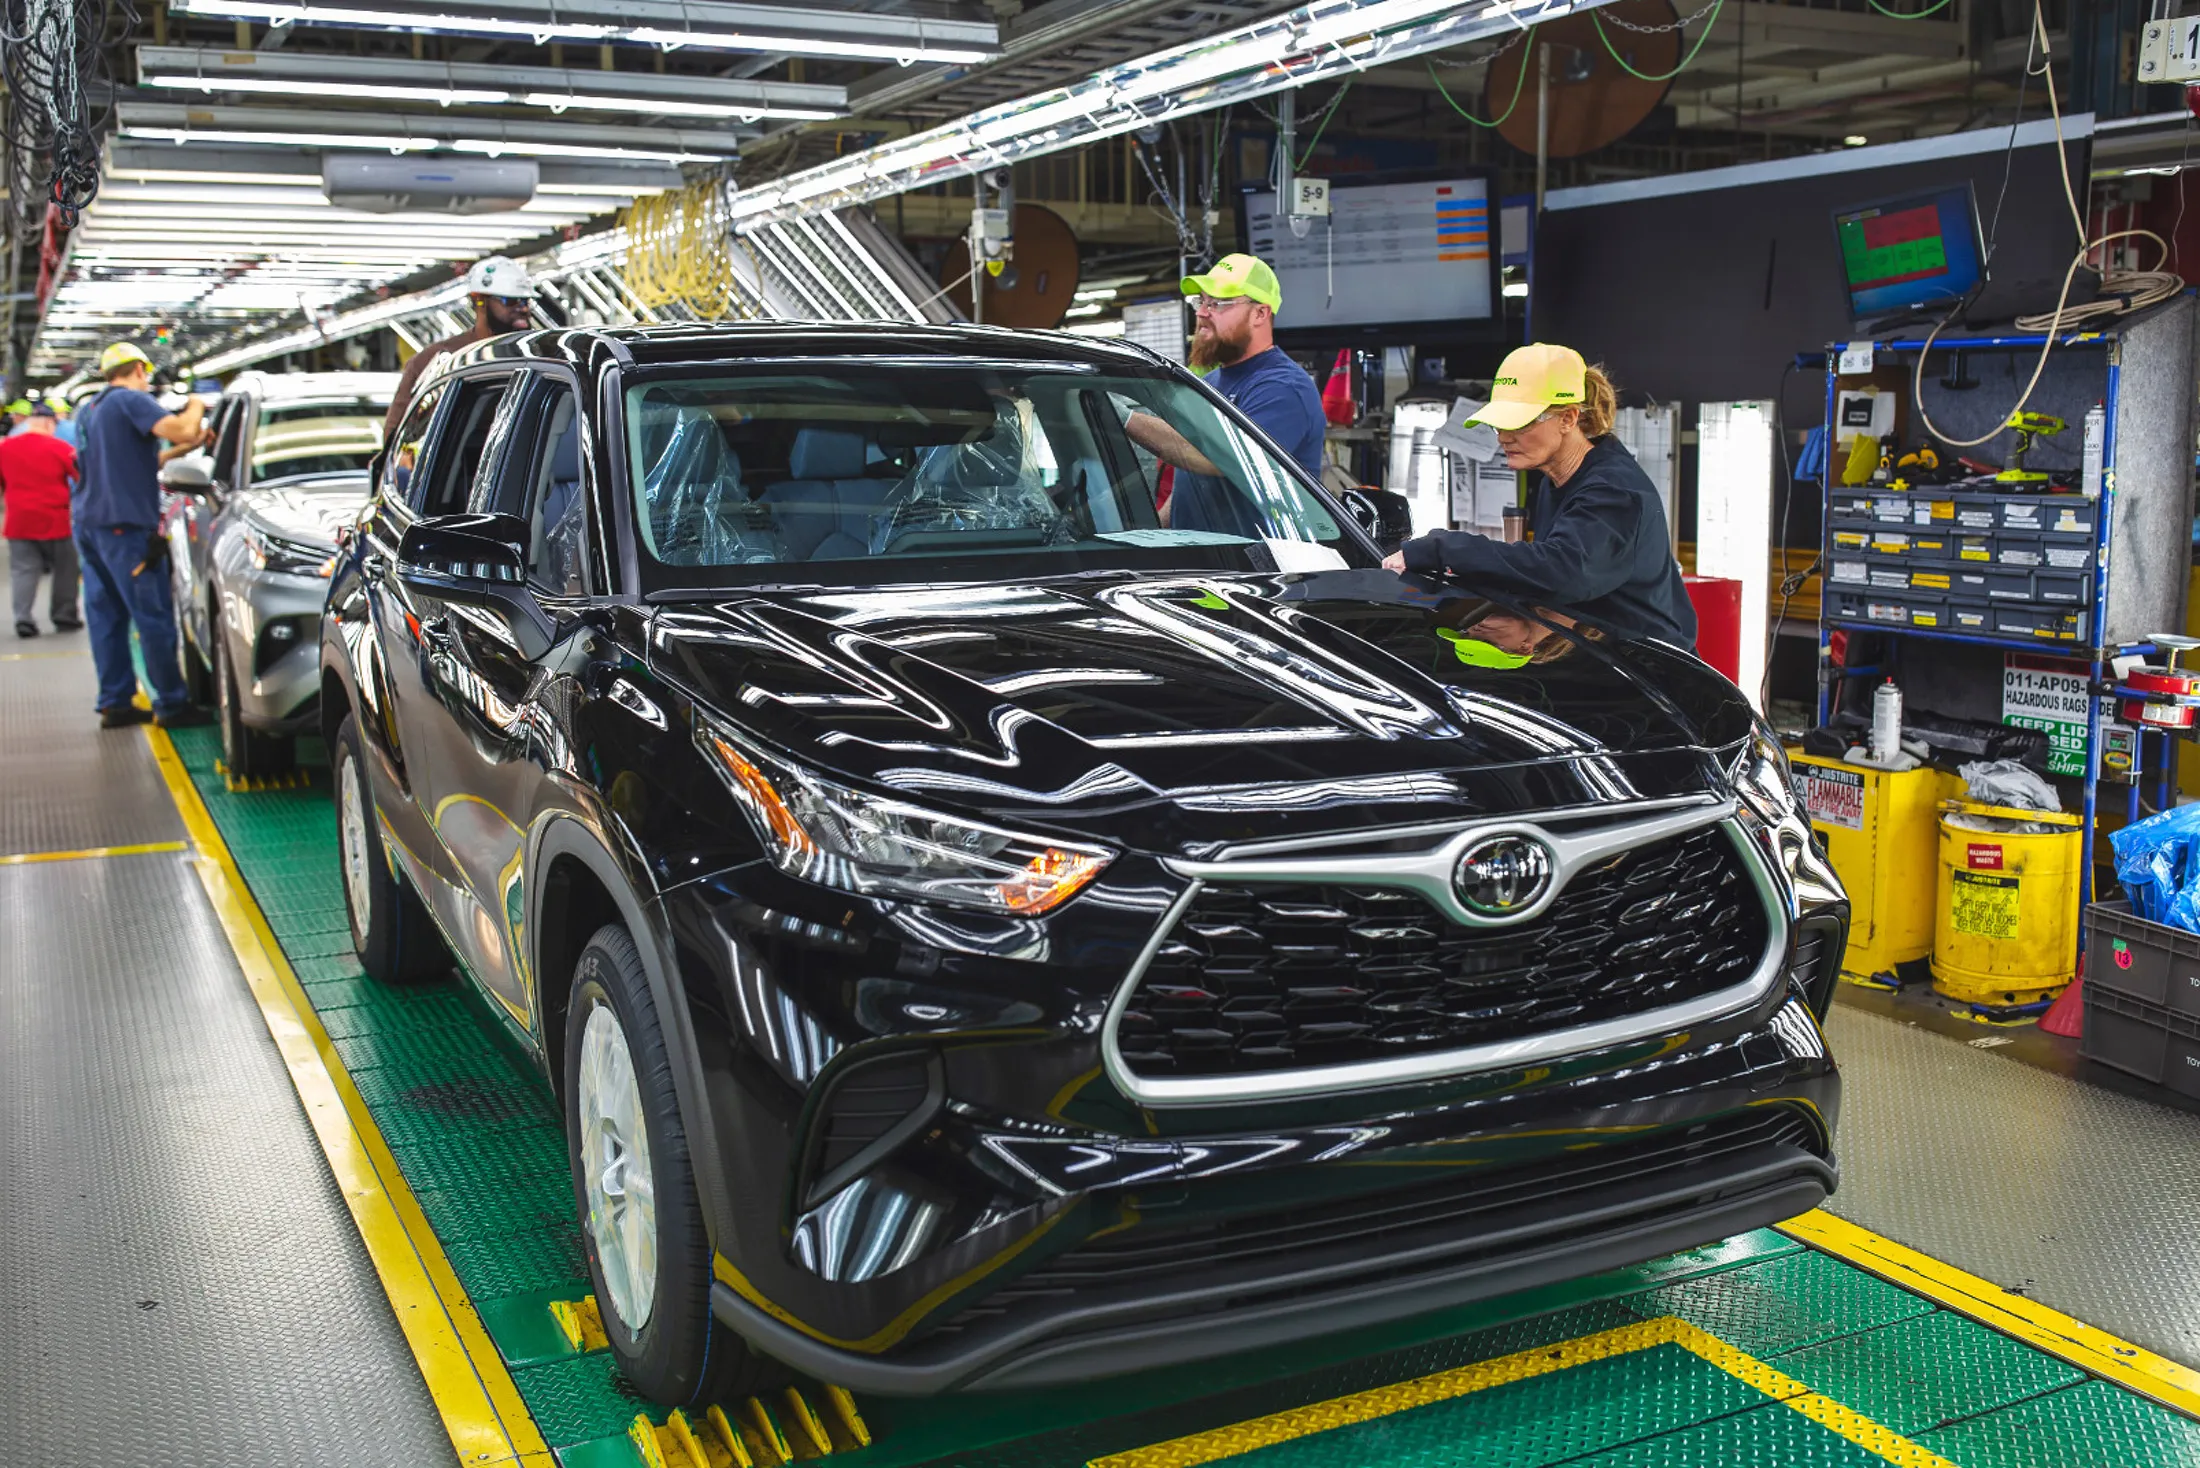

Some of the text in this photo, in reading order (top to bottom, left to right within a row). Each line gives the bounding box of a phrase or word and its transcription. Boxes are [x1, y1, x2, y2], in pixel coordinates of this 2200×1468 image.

[2006, 690, 2060, 710] HAZARDOUS
[2062, 695, 2088, 714] RAGS
[2060, 723, 2088, 738] LID
[1819, 767, 1859, 785] JUSTRITE
[2047, 761, 2086, 775] SHIFT
[1807, 777, 1863, 809] FLAMMABLE
